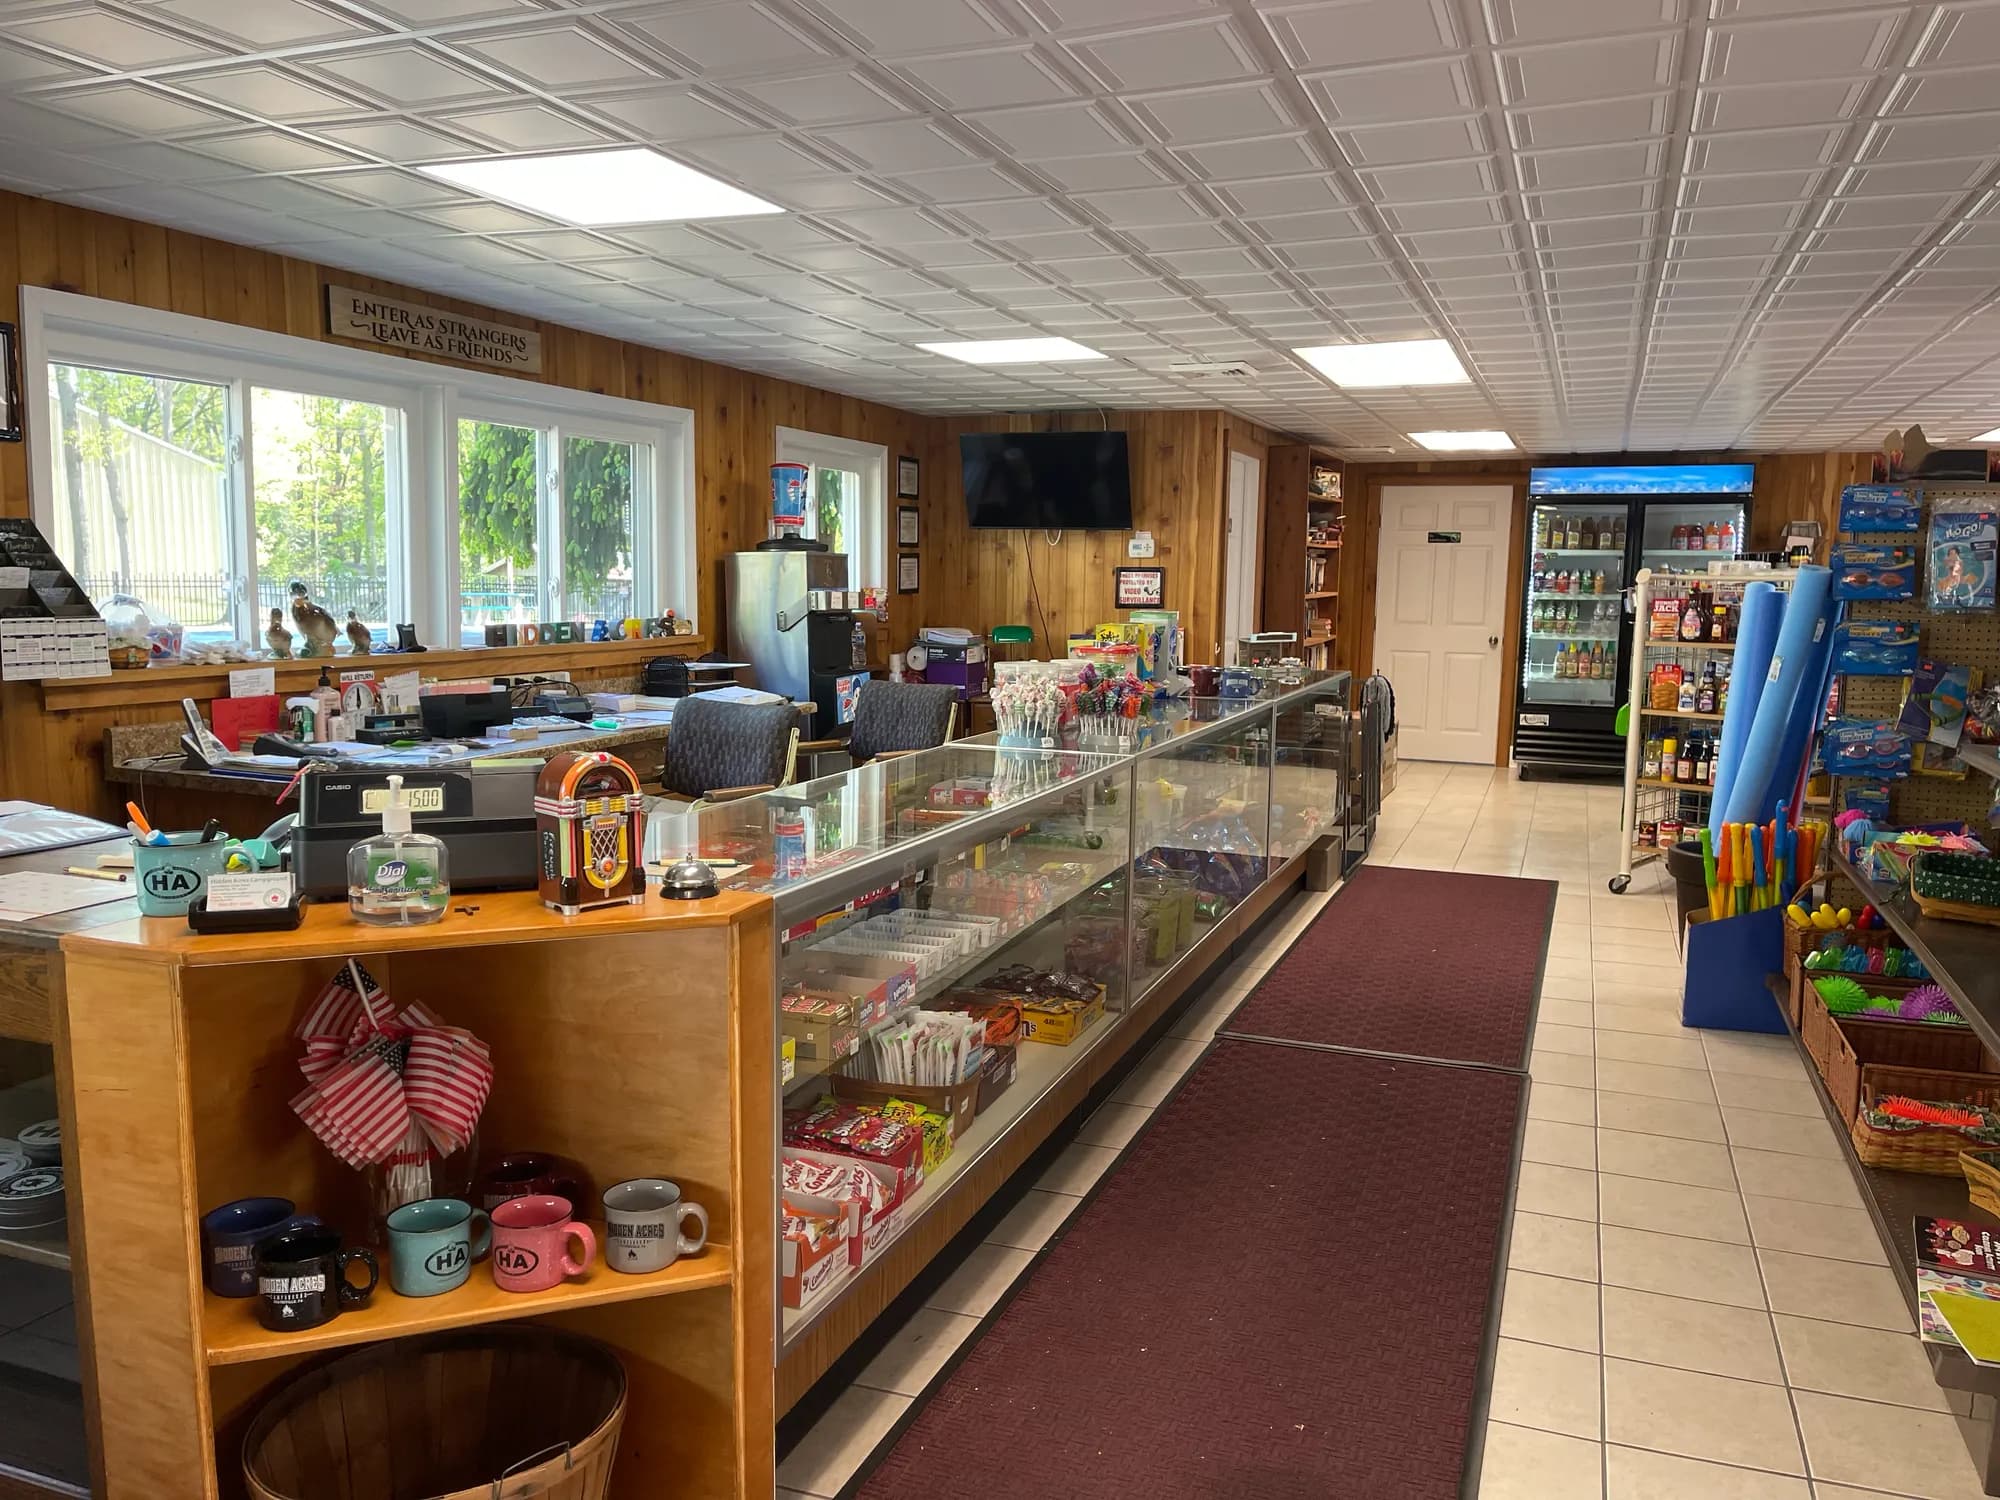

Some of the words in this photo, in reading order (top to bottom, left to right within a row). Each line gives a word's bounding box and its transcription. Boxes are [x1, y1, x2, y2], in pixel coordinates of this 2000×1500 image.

[352, 299, 415, 330] ENTER
[414, 314, 434, 329] AS
[439, 318, 527, 352] STRANGERS
[371, 322, 419, 342] LEAVE
[424, 335, 444, 350] AS
[447, 338, 514, 364] FRIENDS
[1653, 604, 1679, 612] JACK
[355, 673, 374, 681] RETURN
[377, 866, 405, 878] Dial
[152, 874, 190, 890] HA
[636, 1223, 665, 1239] ACRES
[436, 1248, 466, 1271] HA
[499, 1250, 529, 1269] HA
[289, 1274, 326, 1293] ACRES
